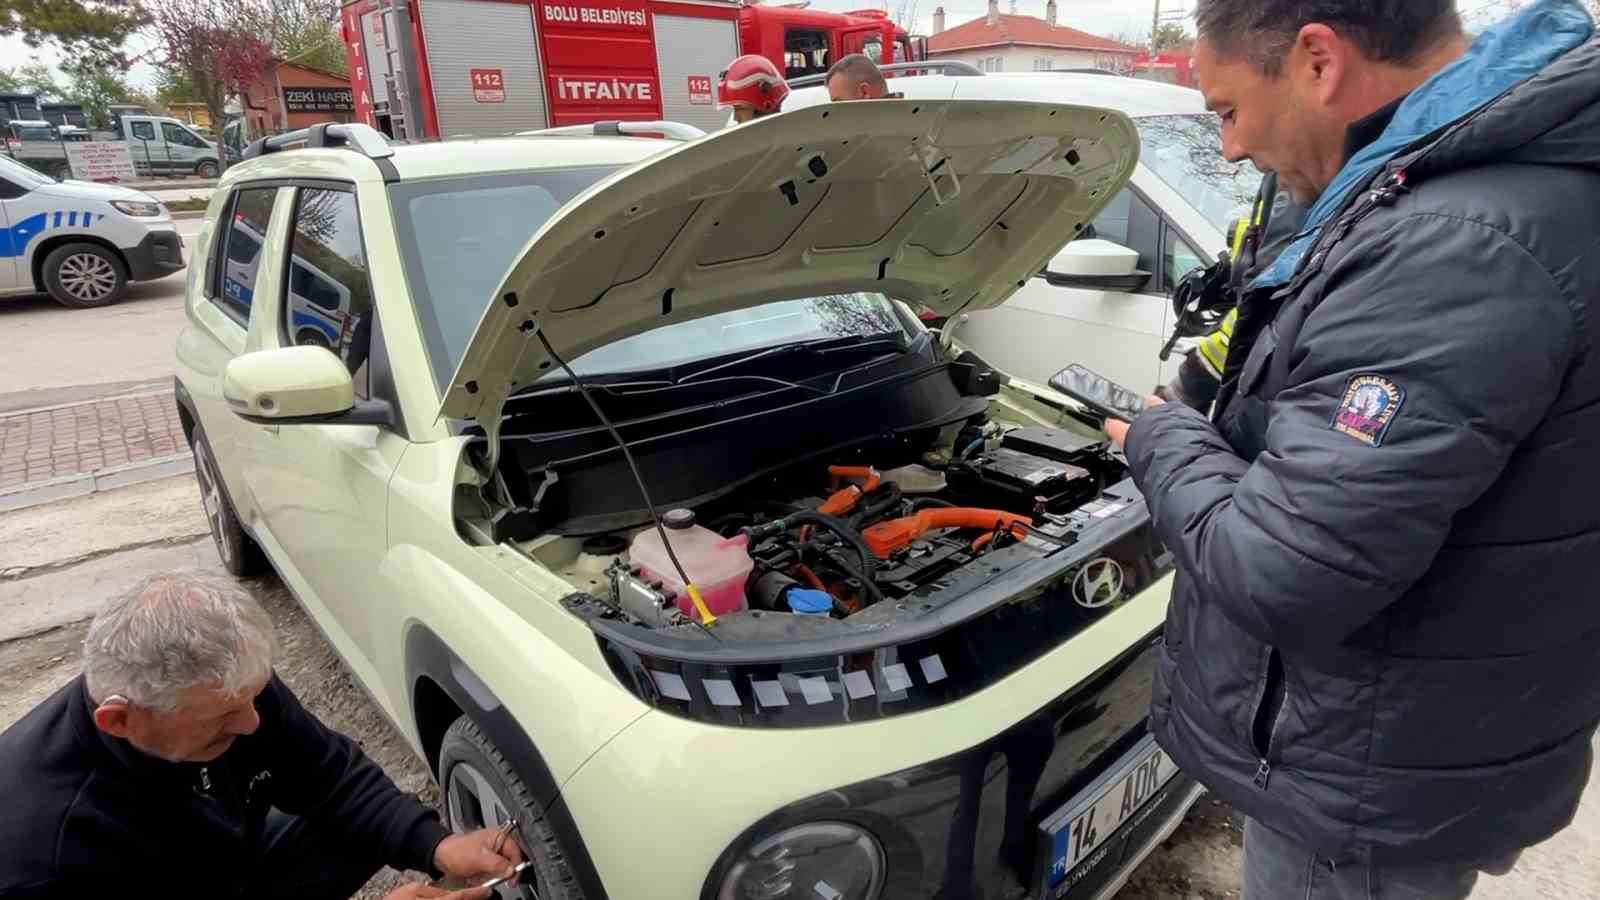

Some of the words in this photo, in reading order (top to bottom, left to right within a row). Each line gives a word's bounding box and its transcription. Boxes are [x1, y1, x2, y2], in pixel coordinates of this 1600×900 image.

[544, 5, 578, 21] BOLU
[581, 7, 647, 26] BELEDİYESİ
[474, 73, 501, 86] 112
[690, 79, 710, 91] 112
[287, 89, 314, 102] ZEKİ
[558, 77, 652, 100] İTFAİYE
[1071, 806, 1097, 862] 14
[1118, 750, 1162, 822] ADR
